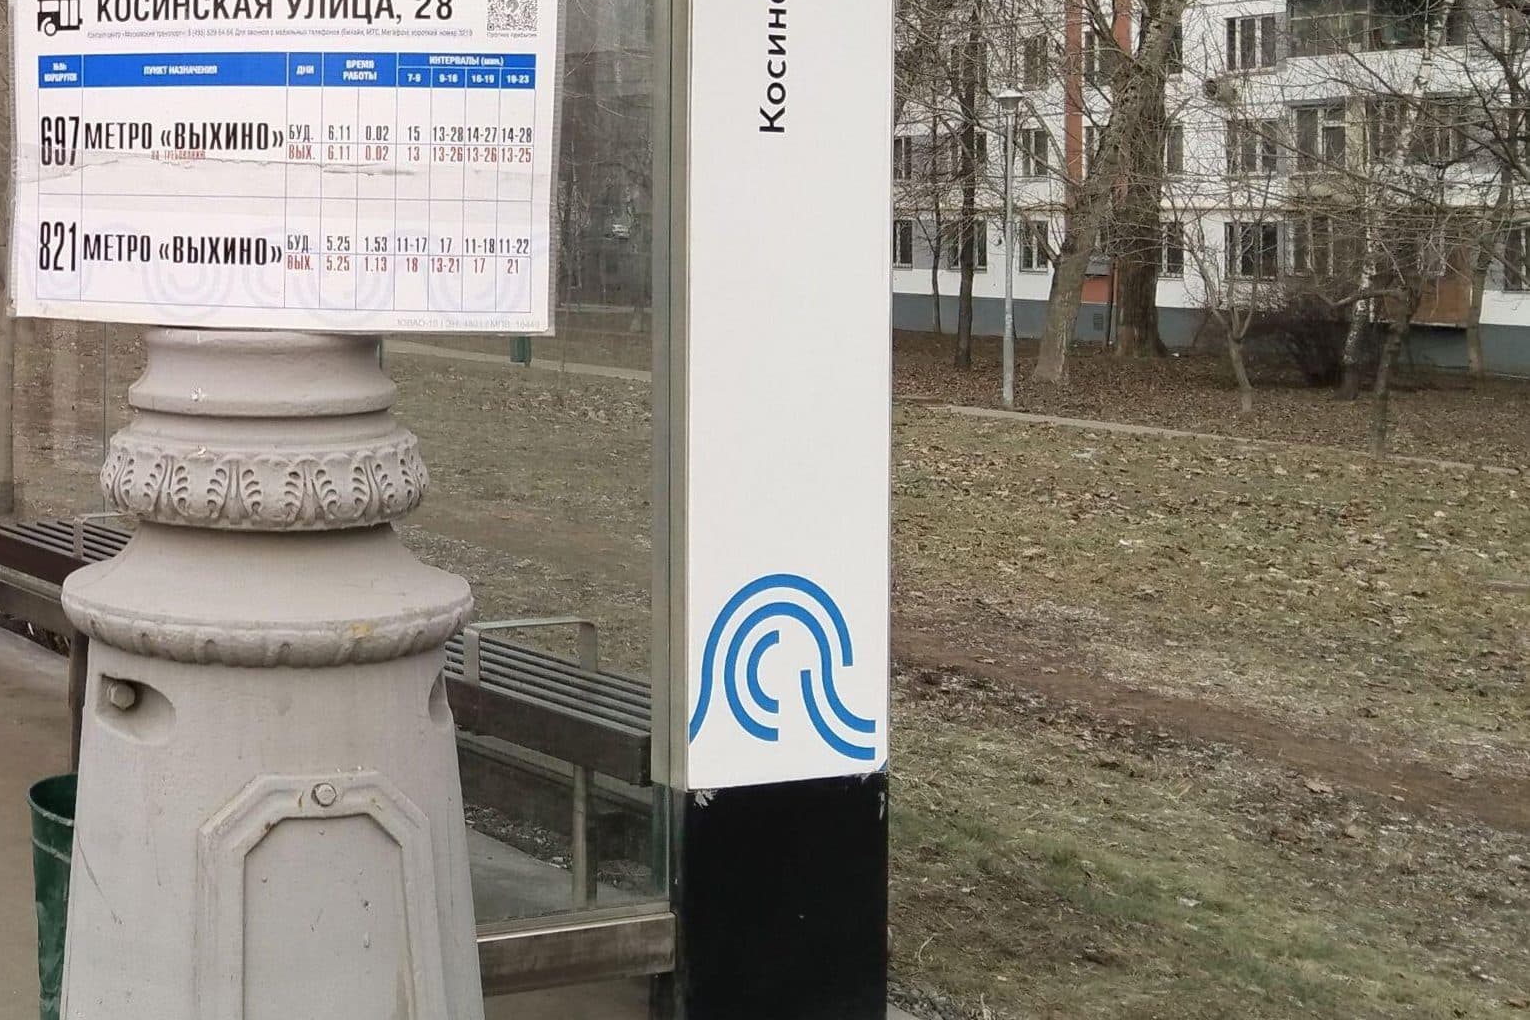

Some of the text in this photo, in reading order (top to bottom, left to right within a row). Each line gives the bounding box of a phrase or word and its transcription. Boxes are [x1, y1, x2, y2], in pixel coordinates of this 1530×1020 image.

[346, 59, 375, 69] ВРЕМЯ
[429, 55, 480, 65] ИНТЕРВАЛЫ
[296, 65, 315, 75] ДНИ
[343, 71, 377, 81] РАБОТЫ
[41, 116, 80, 166] 697
[85, 122, 284, 150] МЕТРО «ВЫХИНО»
[289, 124, 533, 143] БУД. 6.11 0.02 15 13-28 14-27 14-28
[289, 144, 532, 163] ВЫХ. 6.11 0.02 13 13-26 13-26 13-25
[39, 221, 77, 272] 821
[83, 234, 283, 265] МЕТРО «ВЫХИНО»
[287, 235, 529, 254] БУД. 5.25 1.53 11-17 17 11-18 11-22
[287, 255, 519, 274] ВЫХ. 5.25 1.13 18 13-21 17 21
